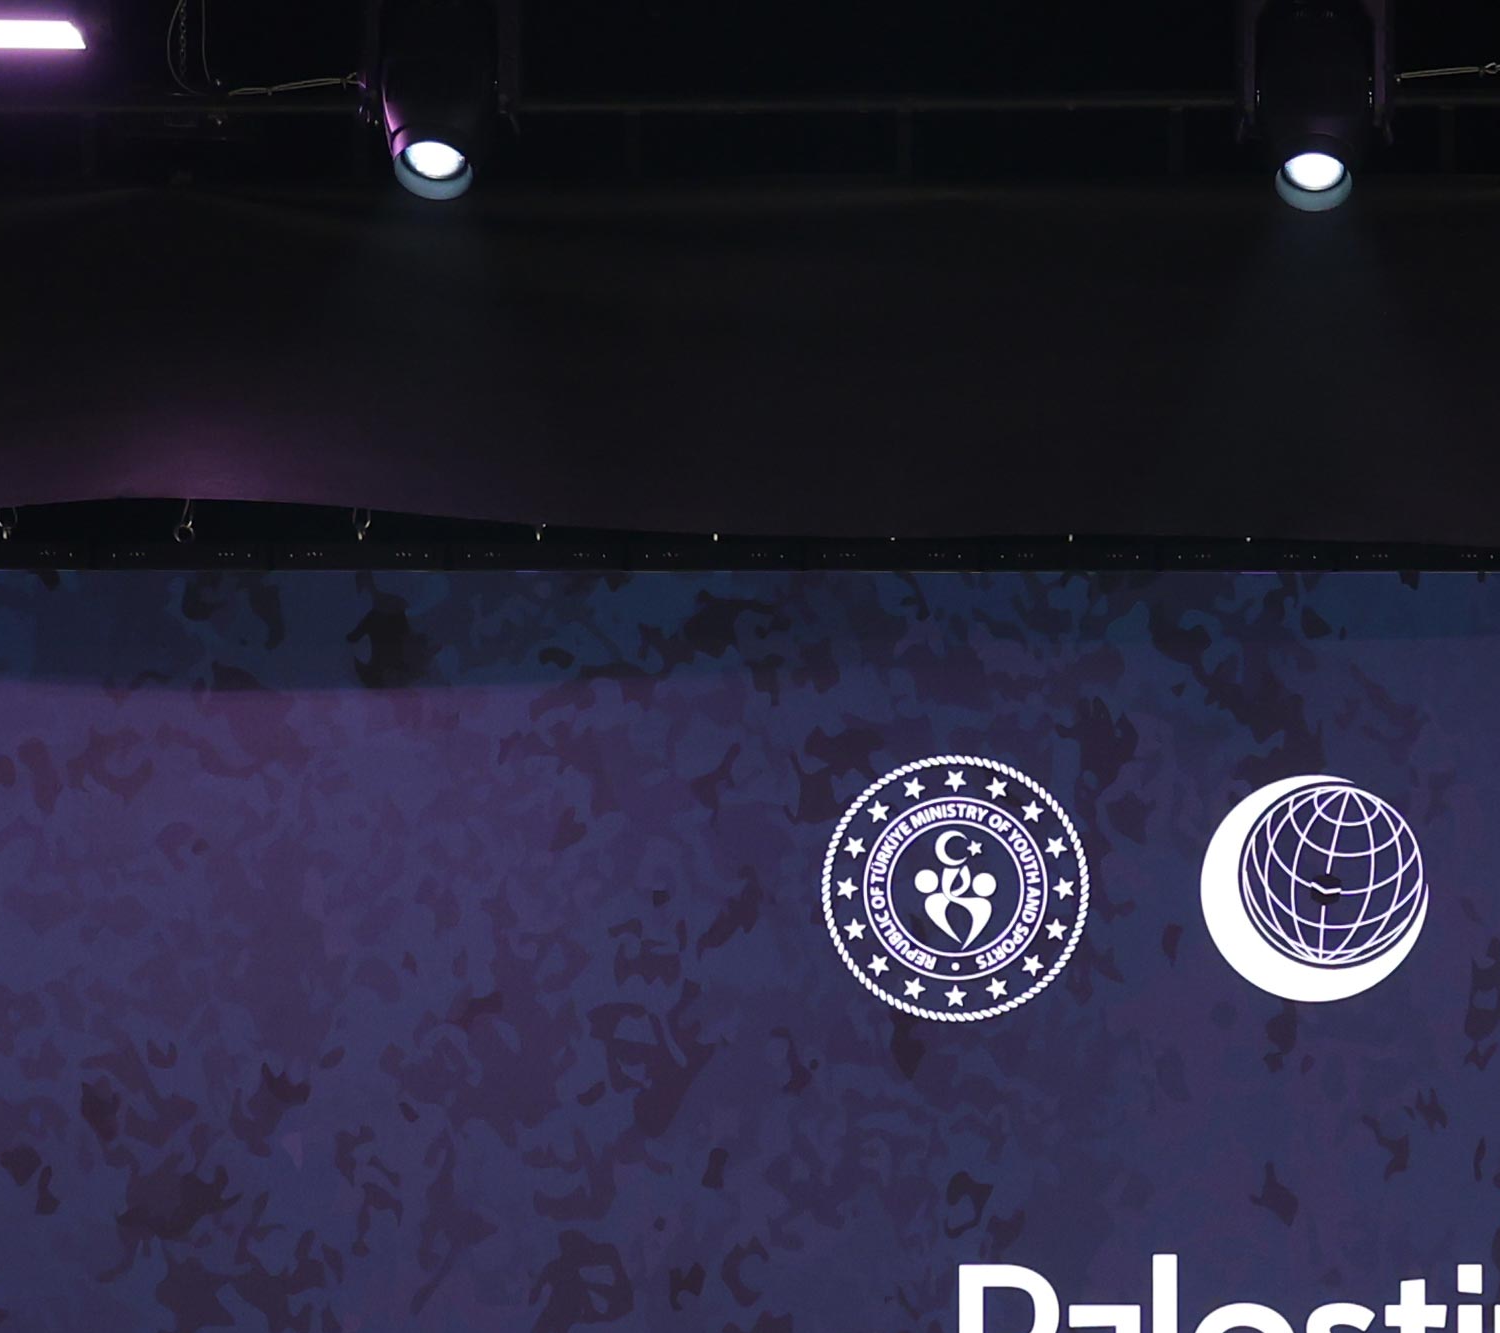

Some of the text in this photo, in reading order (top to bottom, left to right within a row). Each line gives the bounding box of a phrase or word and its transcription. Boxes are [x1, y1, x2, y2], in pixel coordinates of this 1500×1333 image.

[870, 803, 1041, 970] REPUBLIC OF TÜRKİYE MINISTRY OF YOUTH AND SPORTS
